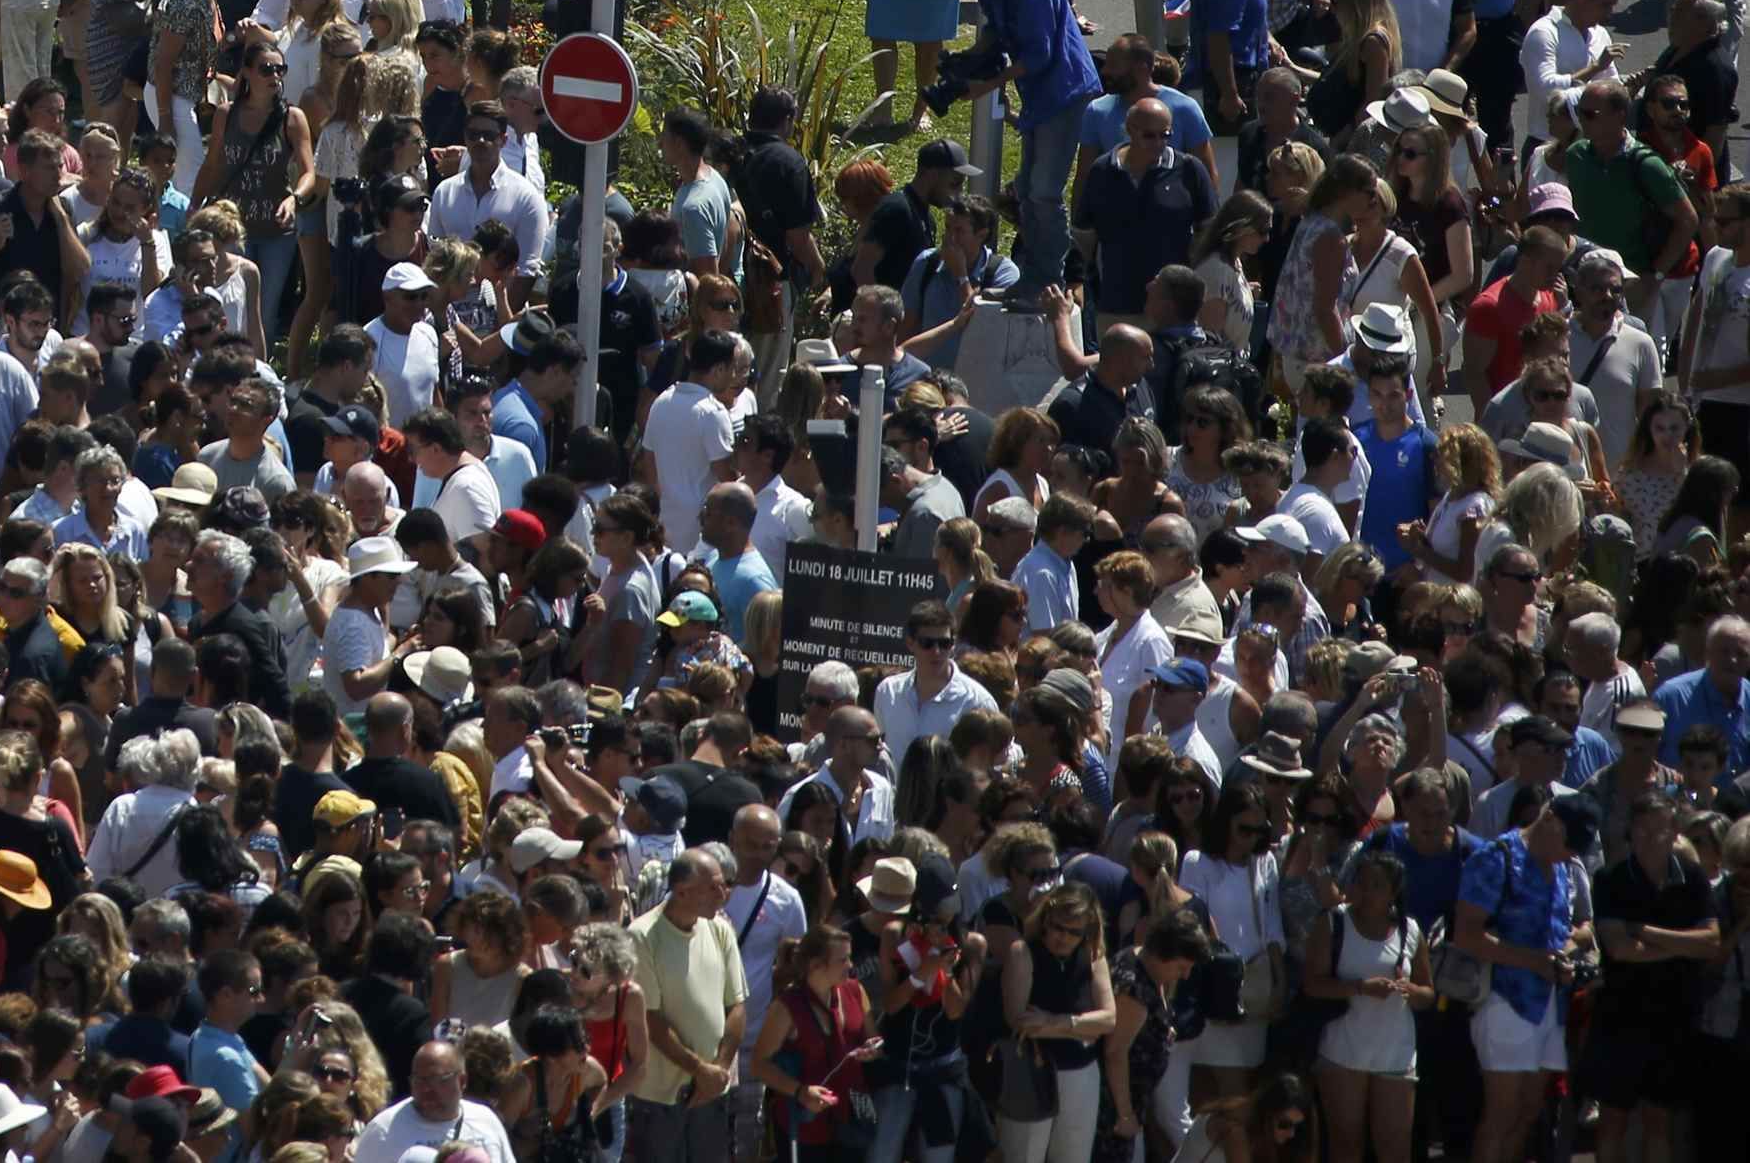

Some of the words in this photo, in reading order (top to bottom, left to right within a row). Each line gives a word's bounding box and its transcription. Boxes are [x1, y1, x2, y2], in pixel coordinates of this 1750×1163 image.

[788, 558, 826, 578] LUNDI
[828, 564, 842, 580] 18
[844, 567, 894, 586] JUILLET
[898, 572, 935, 590] 11H45
[810, 616, 845, 632] MINUTE
[847, 622, 860, 633] DE
[862, 622, 904, 639] SILENCE
[783, 639, 826, 656] MOMENT
[828, 646, 841, 659] DE
[782, 659, 799, 670] SUR
